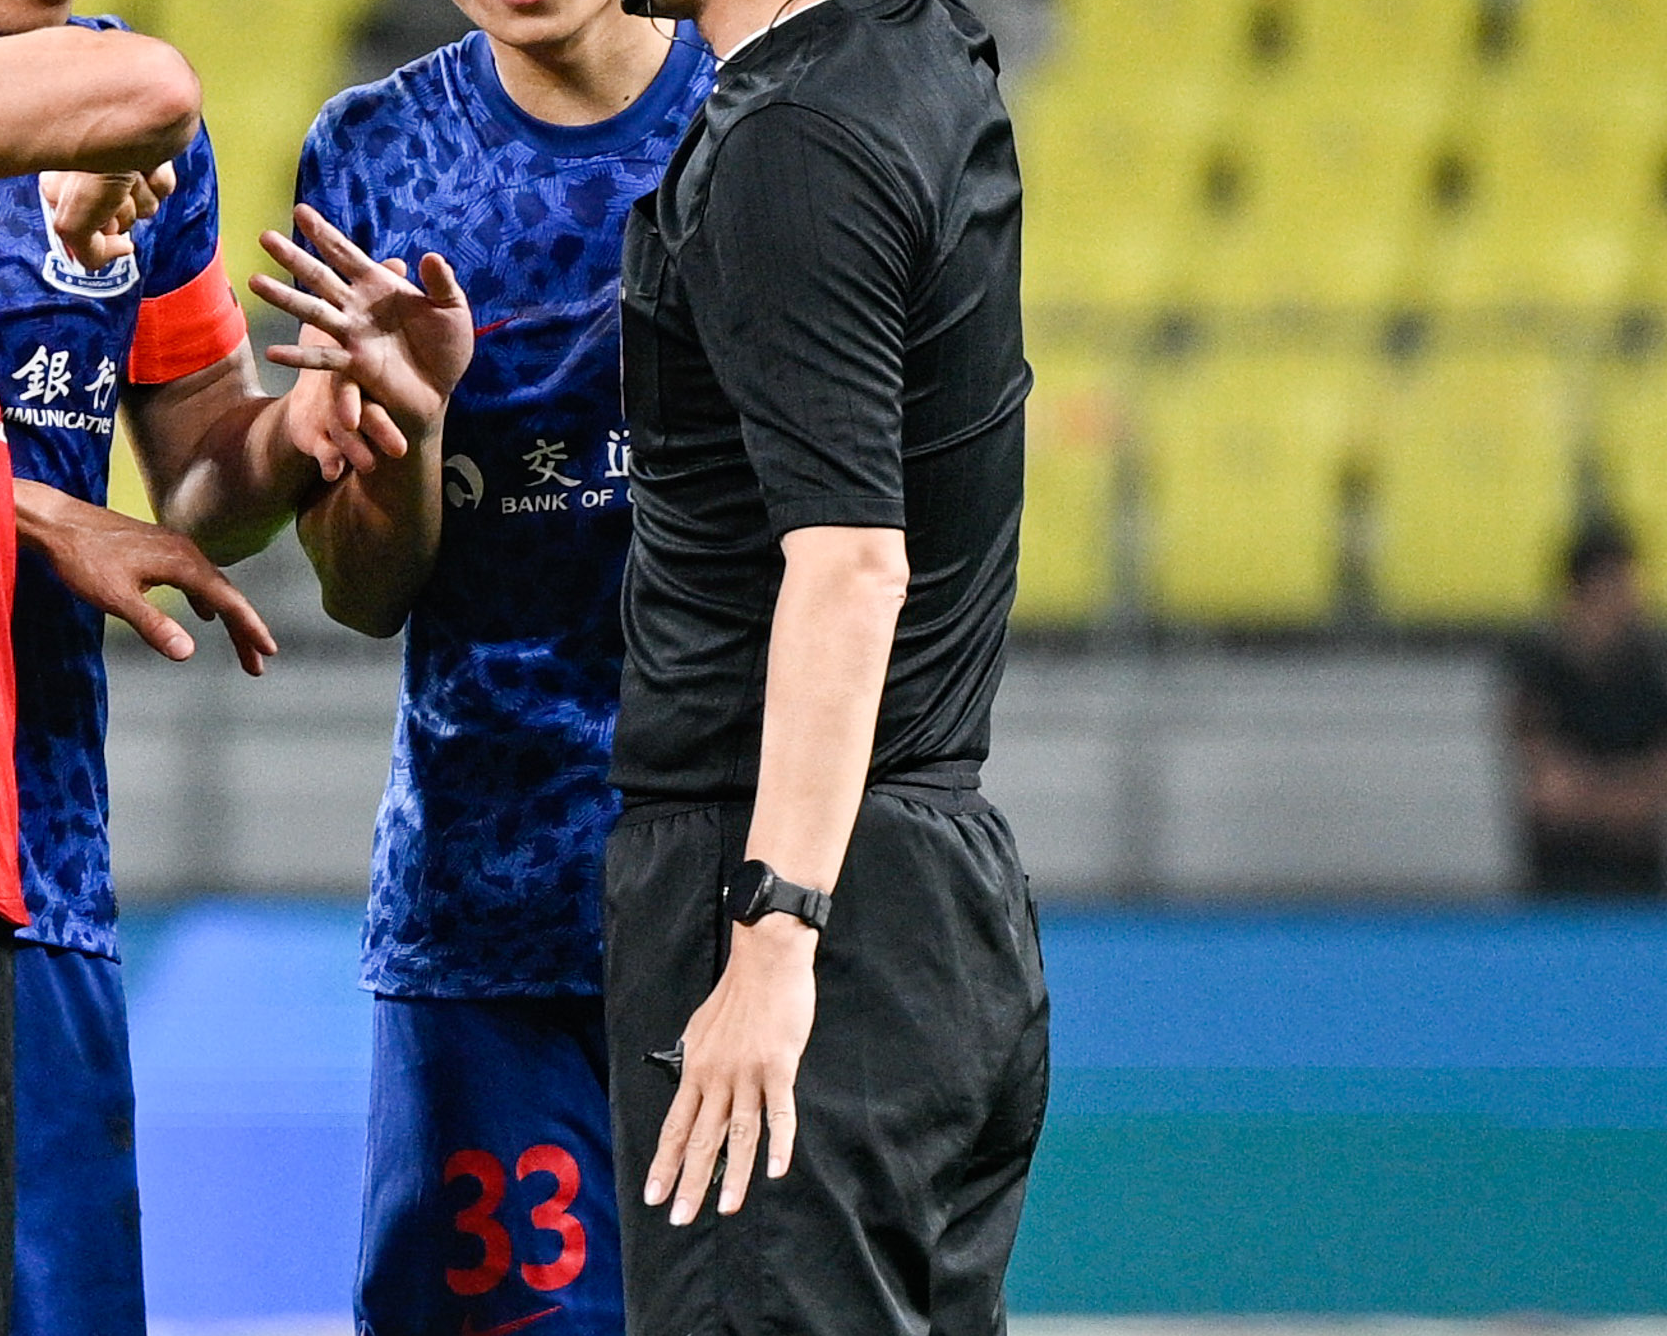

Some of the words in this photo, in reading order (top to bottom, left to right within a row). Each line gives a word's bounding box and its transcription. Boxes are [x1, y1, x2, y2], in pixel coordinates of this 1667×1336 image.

[500, 492, 570, 514] BANK
[581, 488, 615, 508] OF
[443, 1143, 587, 1296] 33
